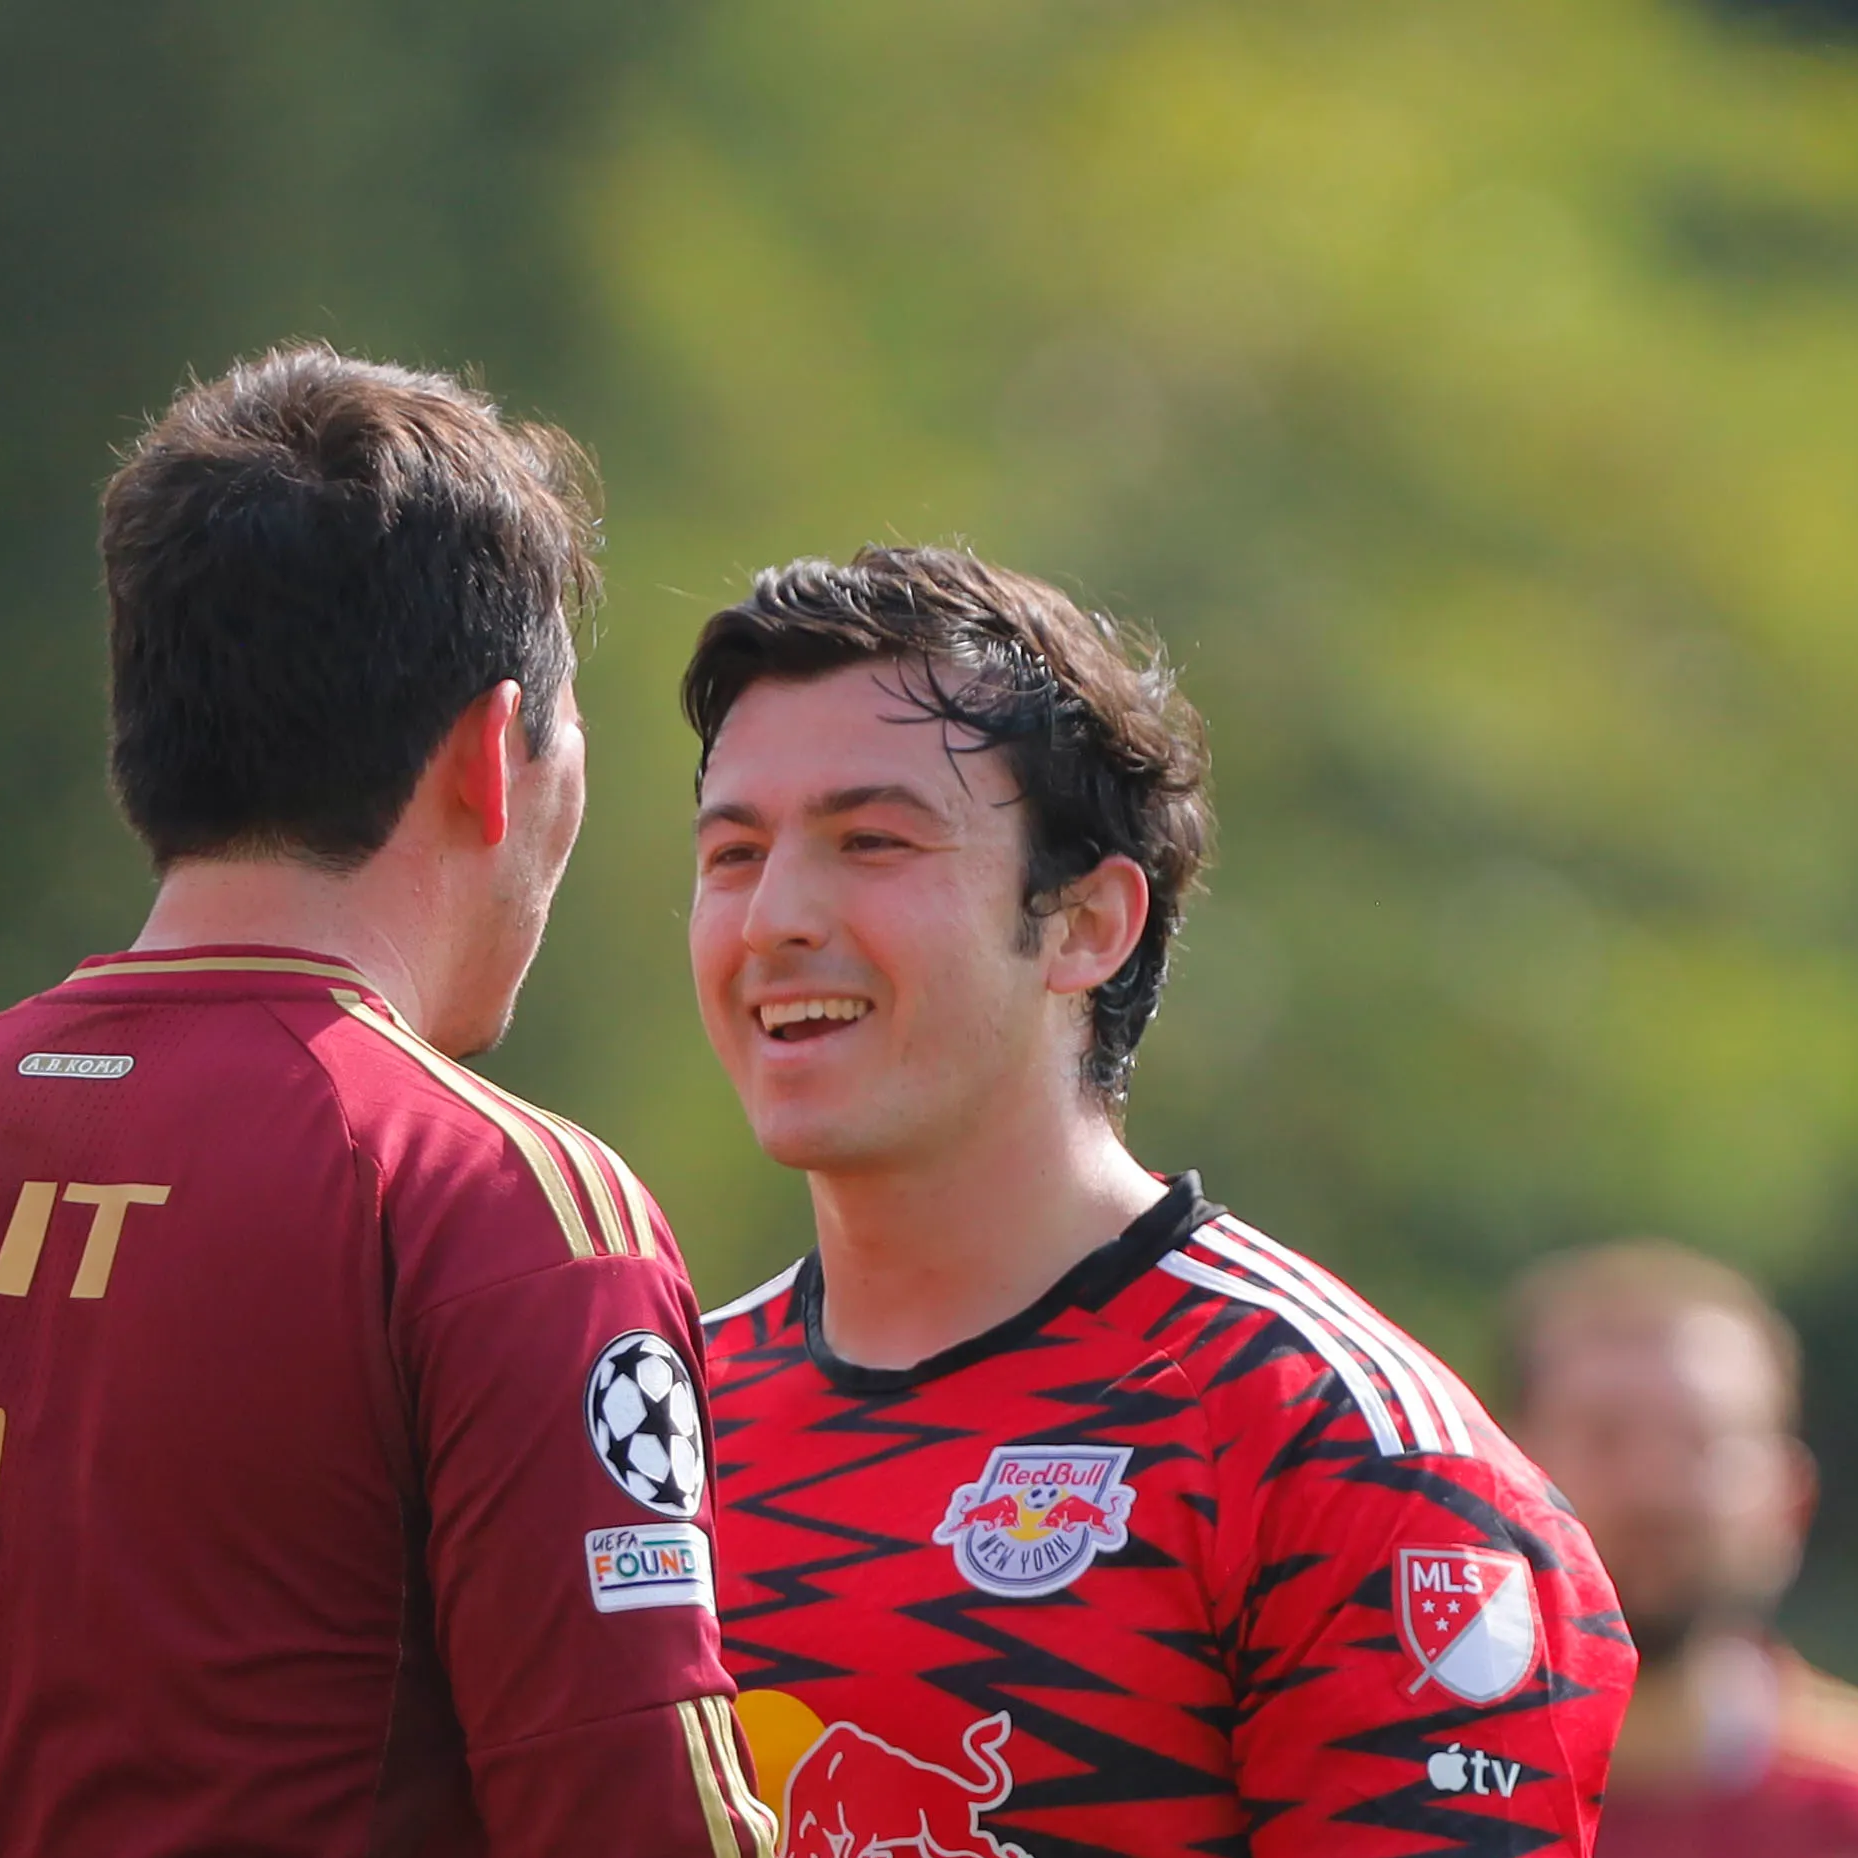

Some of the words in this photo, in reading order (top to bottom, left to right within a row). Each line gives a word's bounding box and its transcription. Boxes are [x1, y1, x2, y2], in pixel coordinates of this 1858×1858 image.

[593, 1531, 640, 1551] UEFA
[977, 1533, 1015, 1571] NEW
[1022, 1535, 1072, 1574] YORK
[1412, 1561, 1484, 1593] MLS
